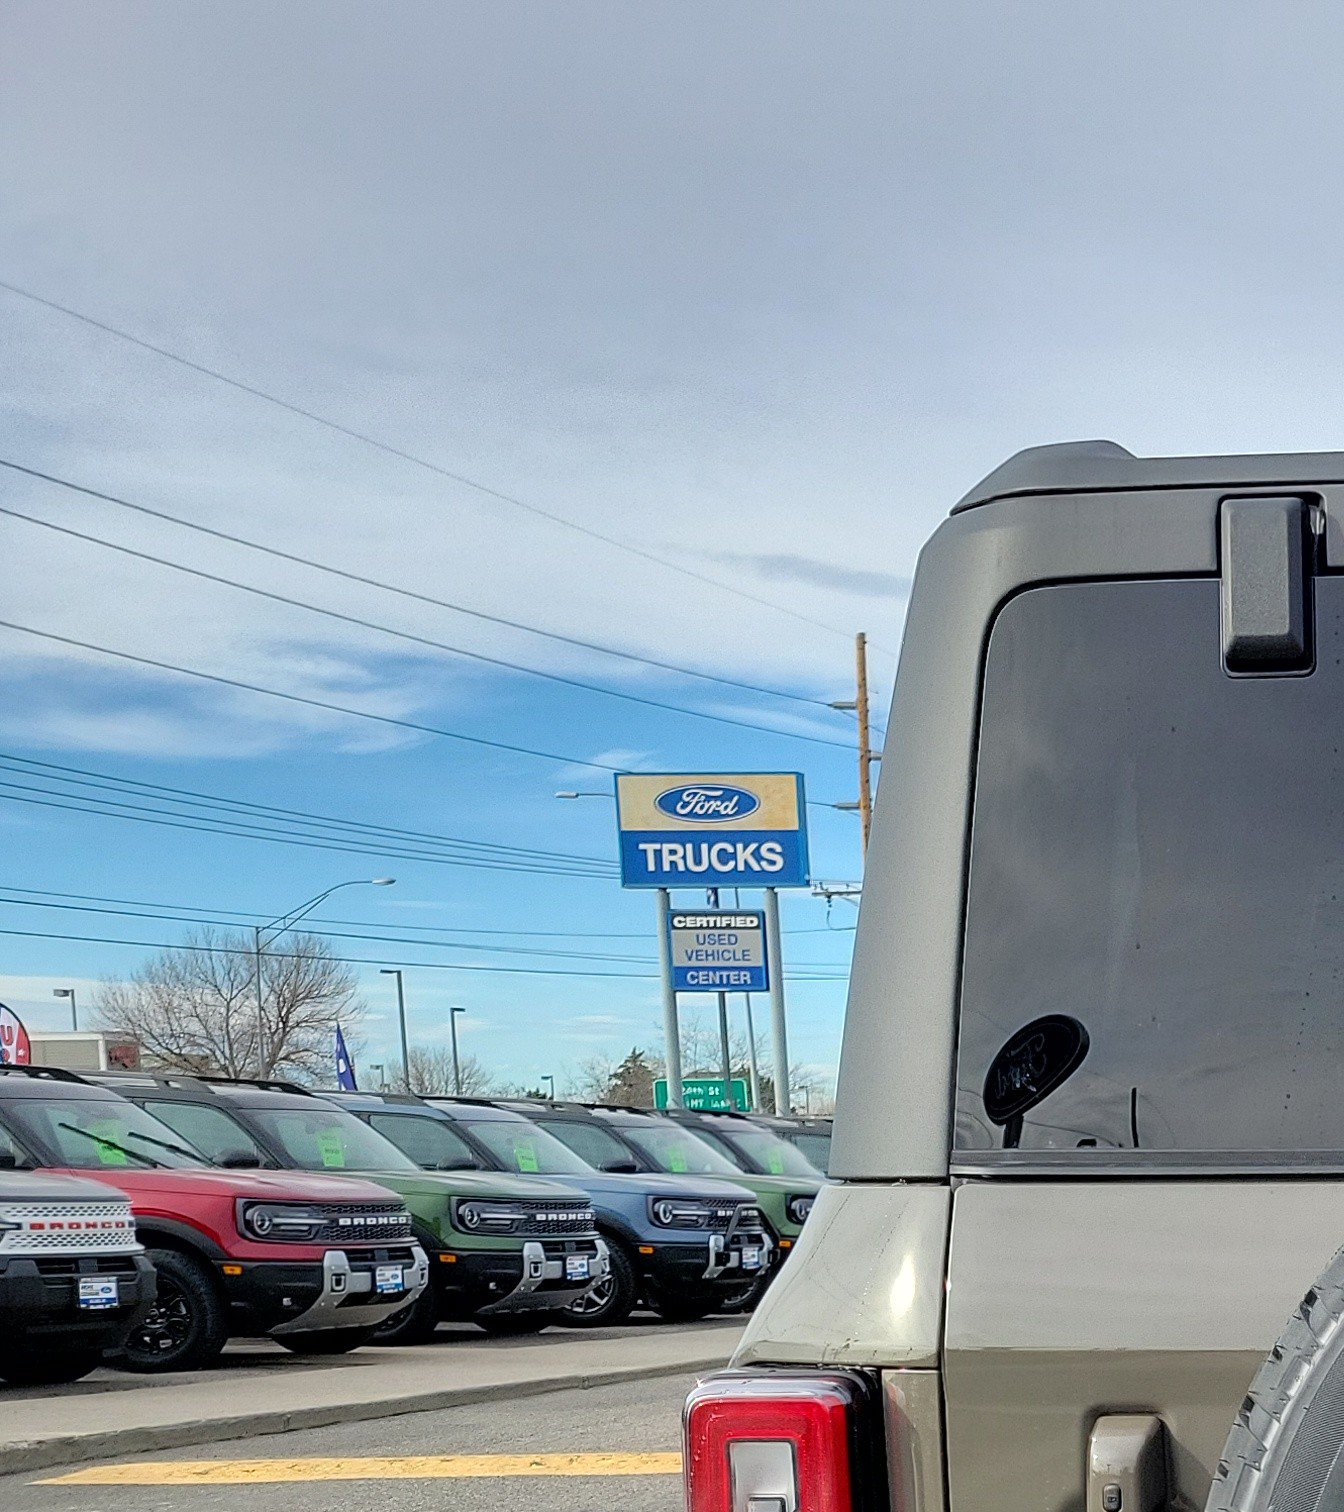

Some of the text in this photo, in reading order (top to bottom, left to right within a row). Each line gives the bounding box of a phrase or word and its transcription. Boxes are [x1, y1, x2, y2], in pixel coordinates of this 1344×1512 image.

[676, 788, 739, 815] Ford
[638, 842, 784, 872] TRUCKS
[672, 916, 759, 928] CERTIFIED
[696, 933, 738, 946] USED
[685, 949, 751, 962] VEHICLE
[686, 970, 751, 985] CENTER
[29, 1221, 126, 1231] BRONCO
[338, 1216, 408, 1226] BRONCO
